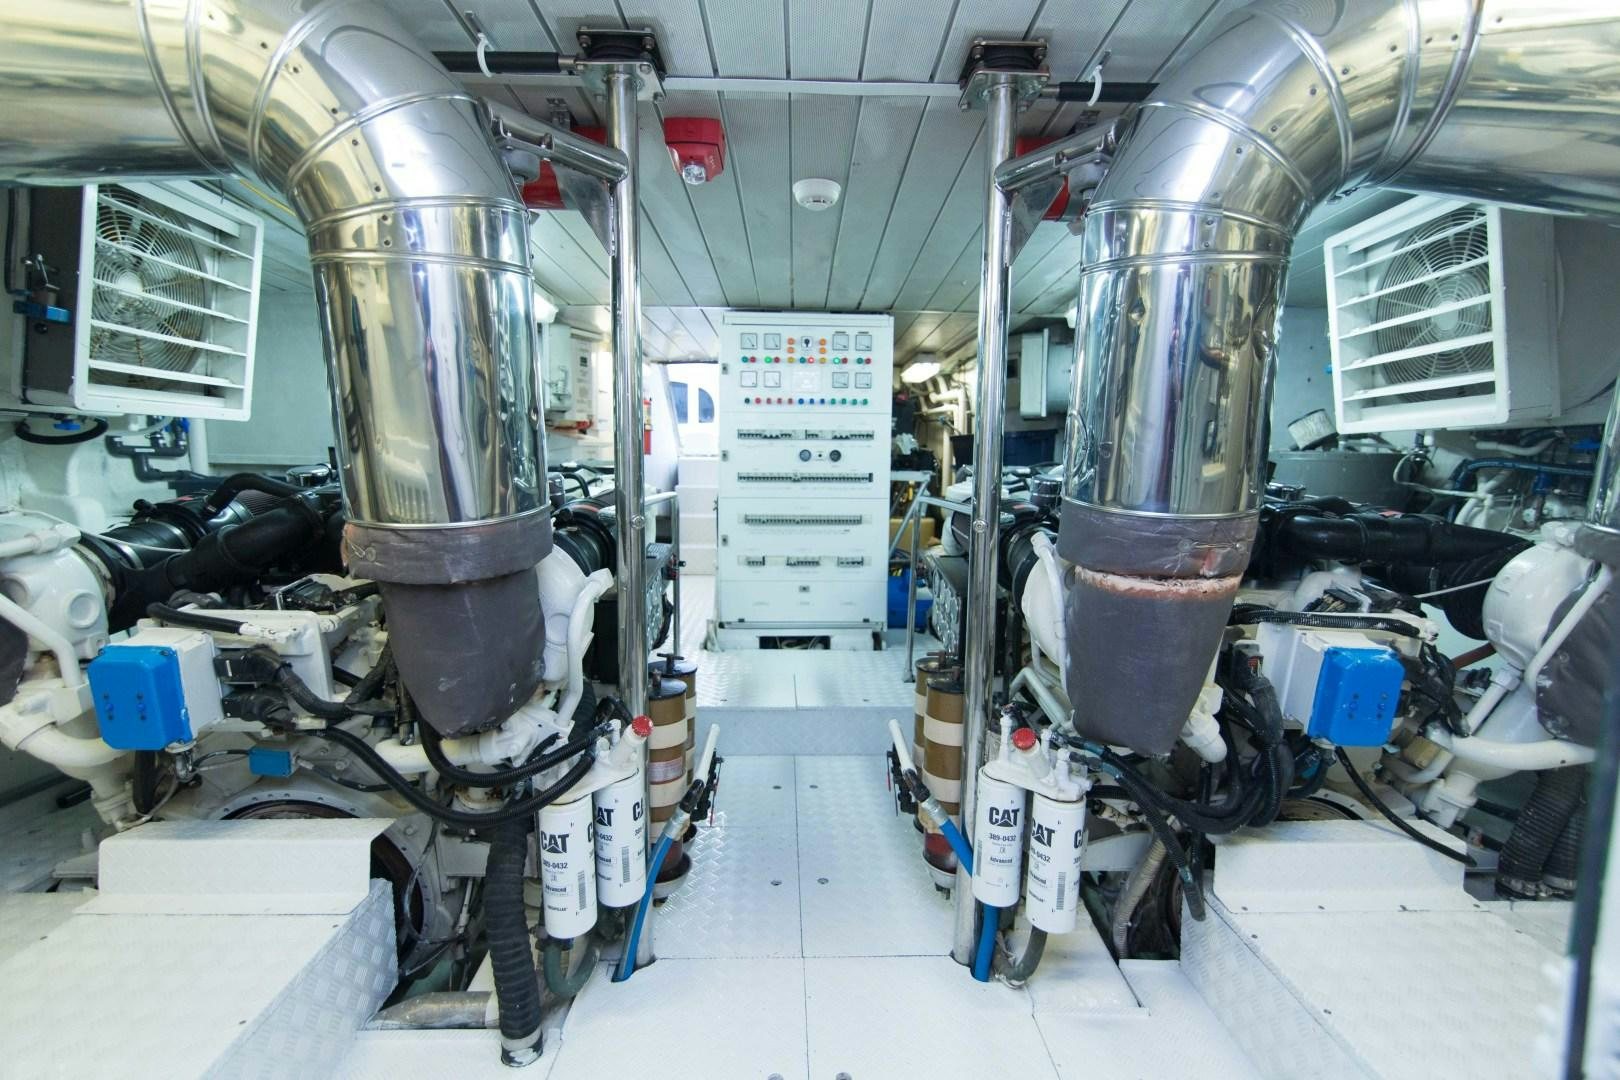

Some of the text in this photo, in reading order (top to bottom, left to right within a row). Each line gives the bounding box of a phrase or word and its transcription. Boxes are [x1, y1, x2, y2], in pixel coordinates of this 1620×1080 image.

[596, 806, 614, 827] AT
[632, 798, 644, 821] CA
[989, 806, 1020, 827] CAT
[540, 830, 569, 853] CAT
